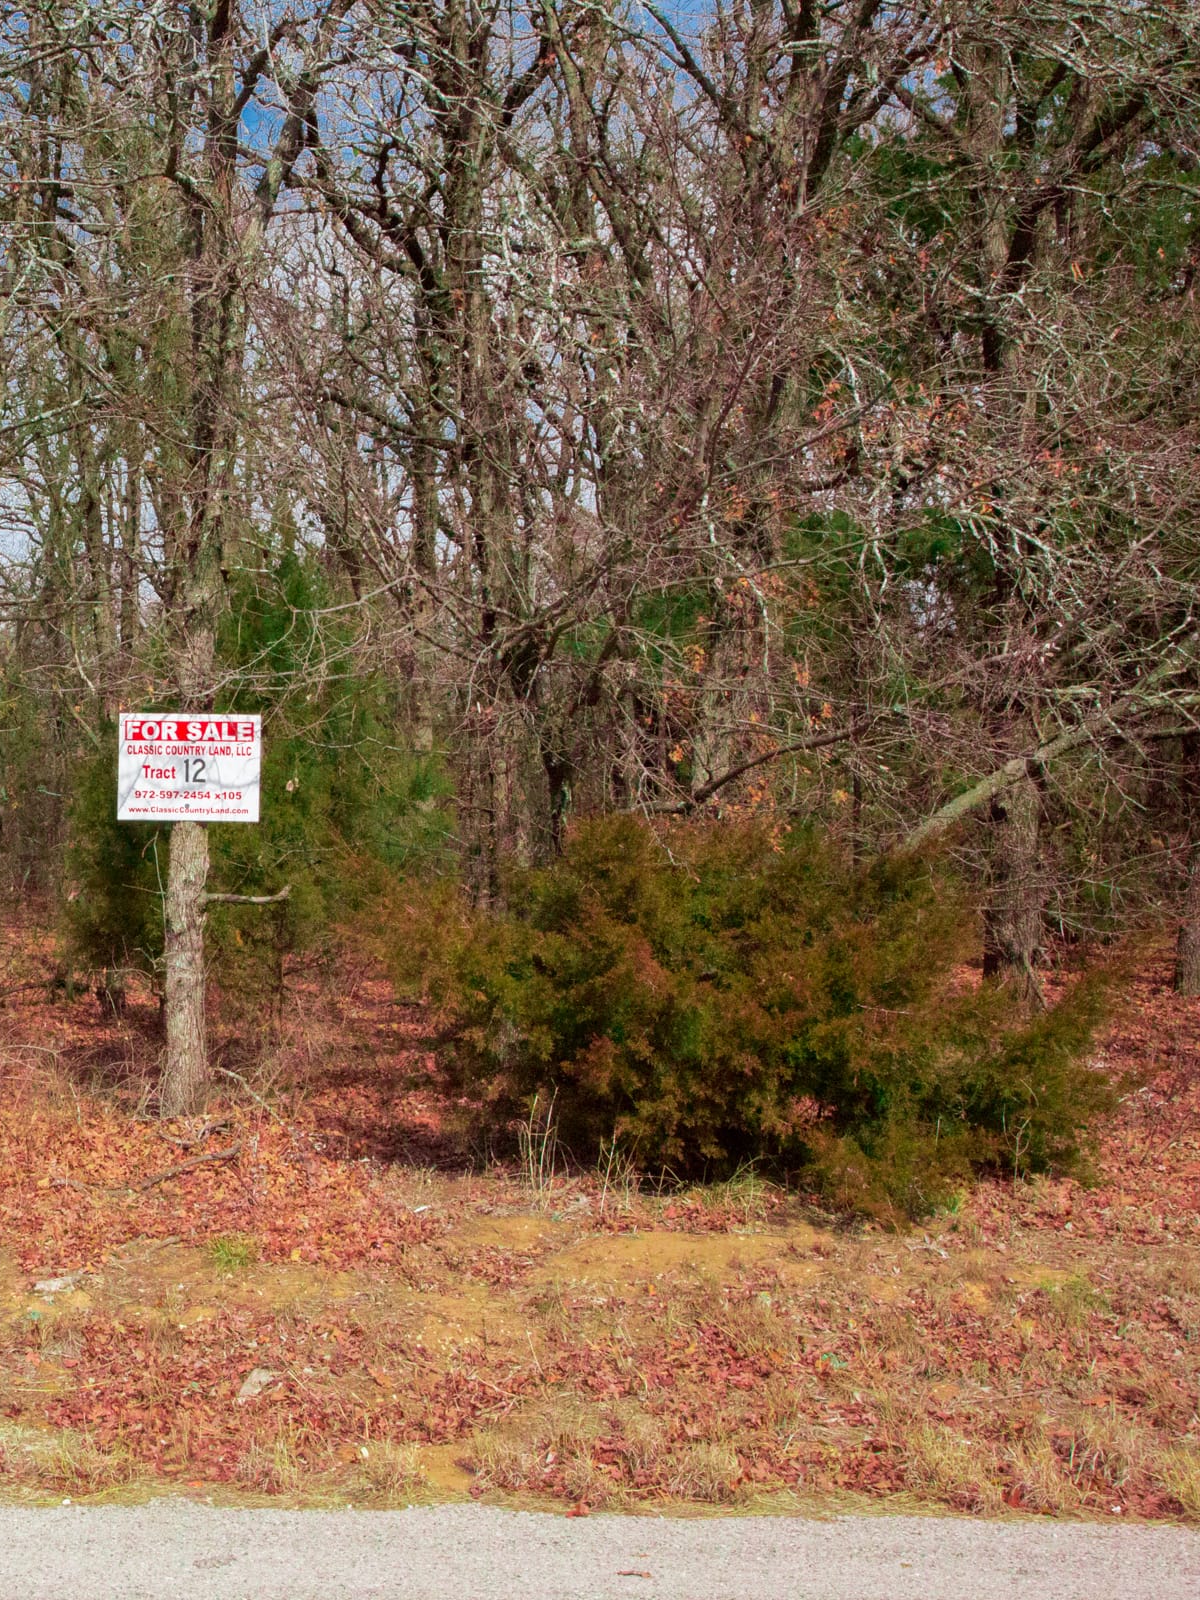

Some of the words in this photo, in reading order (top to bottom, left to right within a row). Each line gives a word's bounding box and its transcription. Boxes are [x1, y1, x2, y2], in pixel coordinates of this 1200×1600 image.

[126, 721, 179, 741] FOR
[186, 722, 254, 742] SALE
[127, 745, 163, 755] CLASSIC
[165, 745, 205, 756] COUNTRY
[208, 746, 234, 757] LAND,
[236, 746, 252, 756] LLC
[142, 765, 176, 779] Tract
[183, 758, 206, 783] 12
[134, 790, 211, 800] 972-597-2454
[214, 791, 242, 800] x105
[128, 805, 249, 815] www.ClassicCountryLand.com
